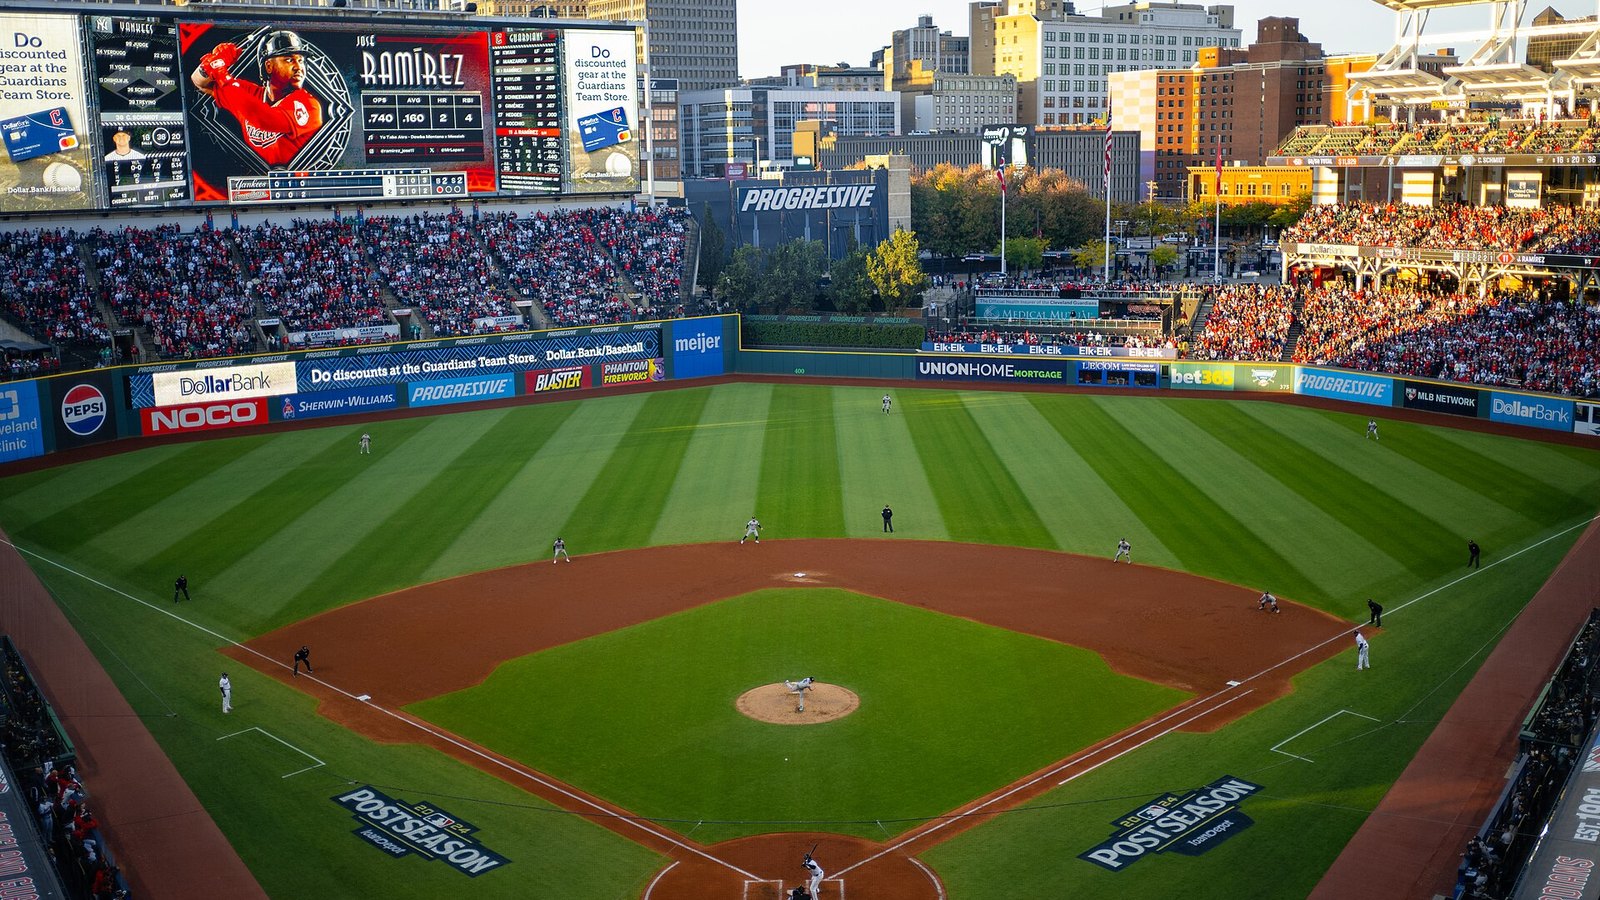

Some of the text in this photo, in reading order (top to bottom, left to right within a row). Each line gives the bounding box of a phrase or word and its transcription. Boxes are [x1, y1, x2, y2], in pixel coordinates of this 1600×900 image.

[120, 22, 153, 34] YANKEES
[14, 32, 42, 47] Do
[509, 32, 543, 42] GUARDIANS
[591, 46, 610, 58] Do
[0, 63, 67, 74] gear at the
[360, 47, 464, 85] RAMÍREZ
[575, 59, 626, 68] discounted
[0, 76, 67, 86] Guardians
[578, 72, 599, 80] gear
[611, 71, 626, 79] the
[578, 81, 625, 90] Guardians
[36, 90, 74, 100] Store.
[576, 92, 630, 101] Team Store.
[368, 114, 473, 122] .740 .160 2 4
[236, 180, 266, 189] Yankees
[741, 186, 876, 211] PROGRESSIVE
[1310, 245, 1344, 254] DollarBank
[1522, 255, 1545, 263] RAMÍREZ
[1002, 309, 1045, 318] MEDICAL
[676, 333, 721, 353] meijer
[305, 350, 341, 358] PROGRESSIVE
[357, 346, 391, 354] PROGRESSIVE
[196, 360, 234, 368] PROGRESSIVE
[251, 355, 289, 363] PROGRESSIVE
[312, 342, 644, 383] Do discounts at the Guardians Team Store. Dollar.Bank/Baseball
[138, 364, 178, 373] PROGRESSIVE
[604, 361, 648, 374] PHANTOM
[604, 372, 649, 383] FIREWORKS
[1014, 370, 1062, 379] MORTGAGE
[1171, 369, 1233, 386] bet365
[180, 370, 270, 396] DollarBank
[535, 370, 582, 392] BLASTER
[1297, 373, 1386, 398] PROGRESSIVE
[412, 379, 508, 402] PROGRESSIVE
[1418, 392, 1475, 407] MLB NETWORK
[64, 402, 104, 418] PEPSI
[1493, 398, 1568, 423] DollarBank
[151, 402, 257, 431] NOCO
[1158, 797, 1178, 807] 24
[414, 804, 434, 815] 20
[1088, 779, 1256, 867] POSTSEASON
[1120, 816, 1140, 828] 20
[339, 789, 498, 874] POSTSEASON
[451, 824, 471, 834] 24
[1188, 819, 1235, 846] loanDepot
[360, 829, 406, 854] loanDepot
